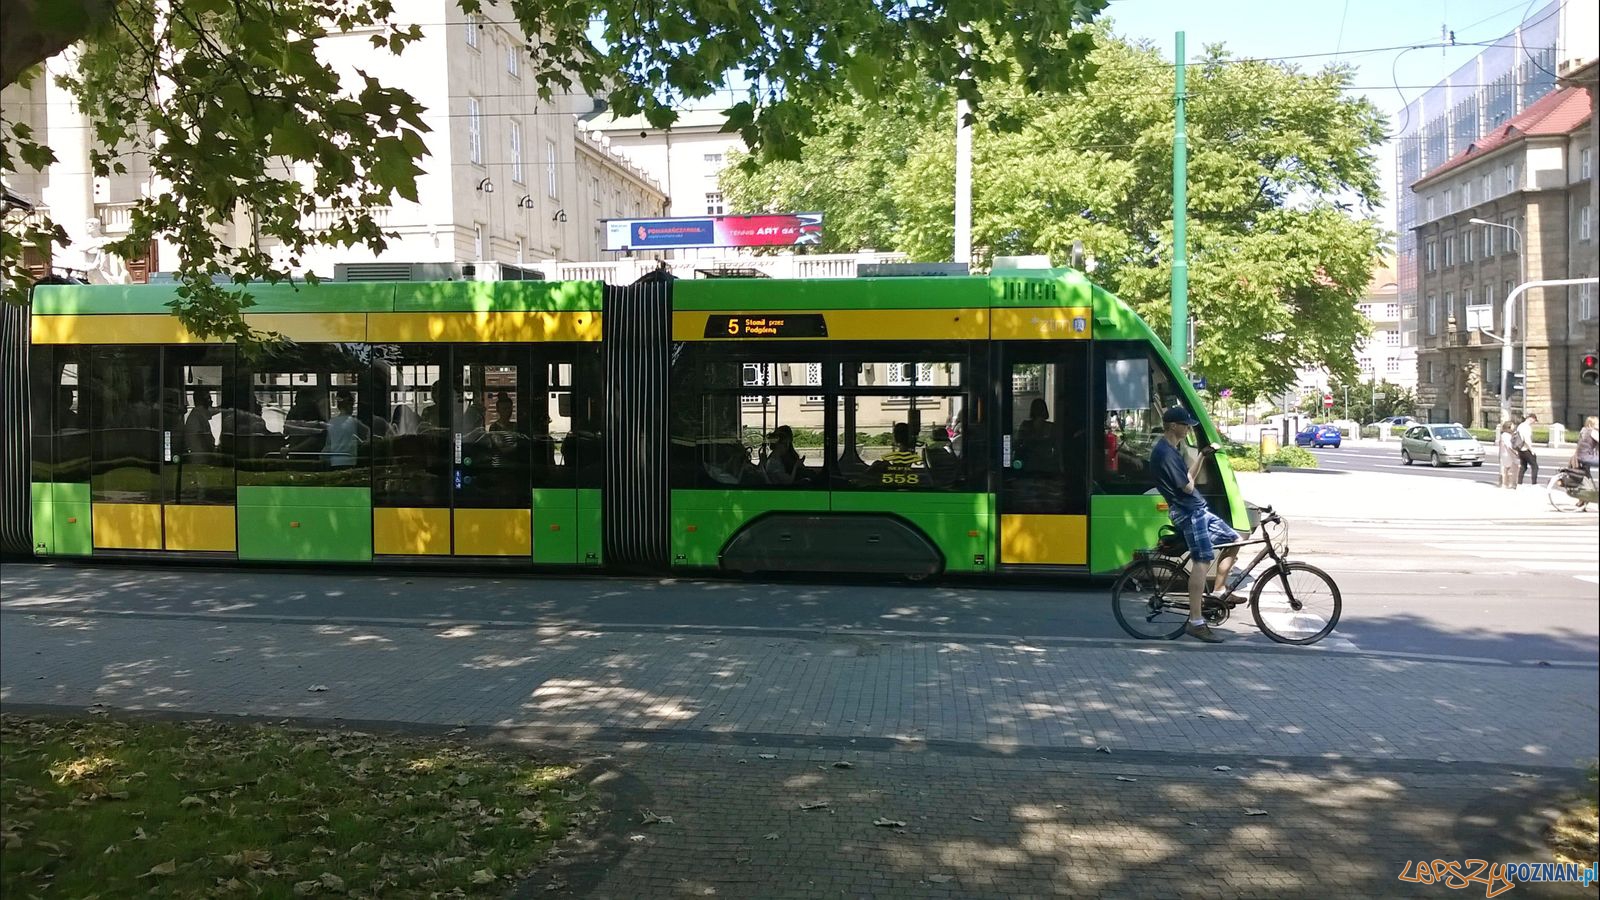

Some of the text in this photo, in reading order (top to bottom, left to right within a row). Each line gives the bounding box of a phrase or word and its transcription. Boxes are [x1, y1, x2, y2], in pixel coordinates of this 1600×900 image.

[756, 227, 779, 235] ART
[728, 318, 739, 334] 5
[881, 473, 919, 484] 558
